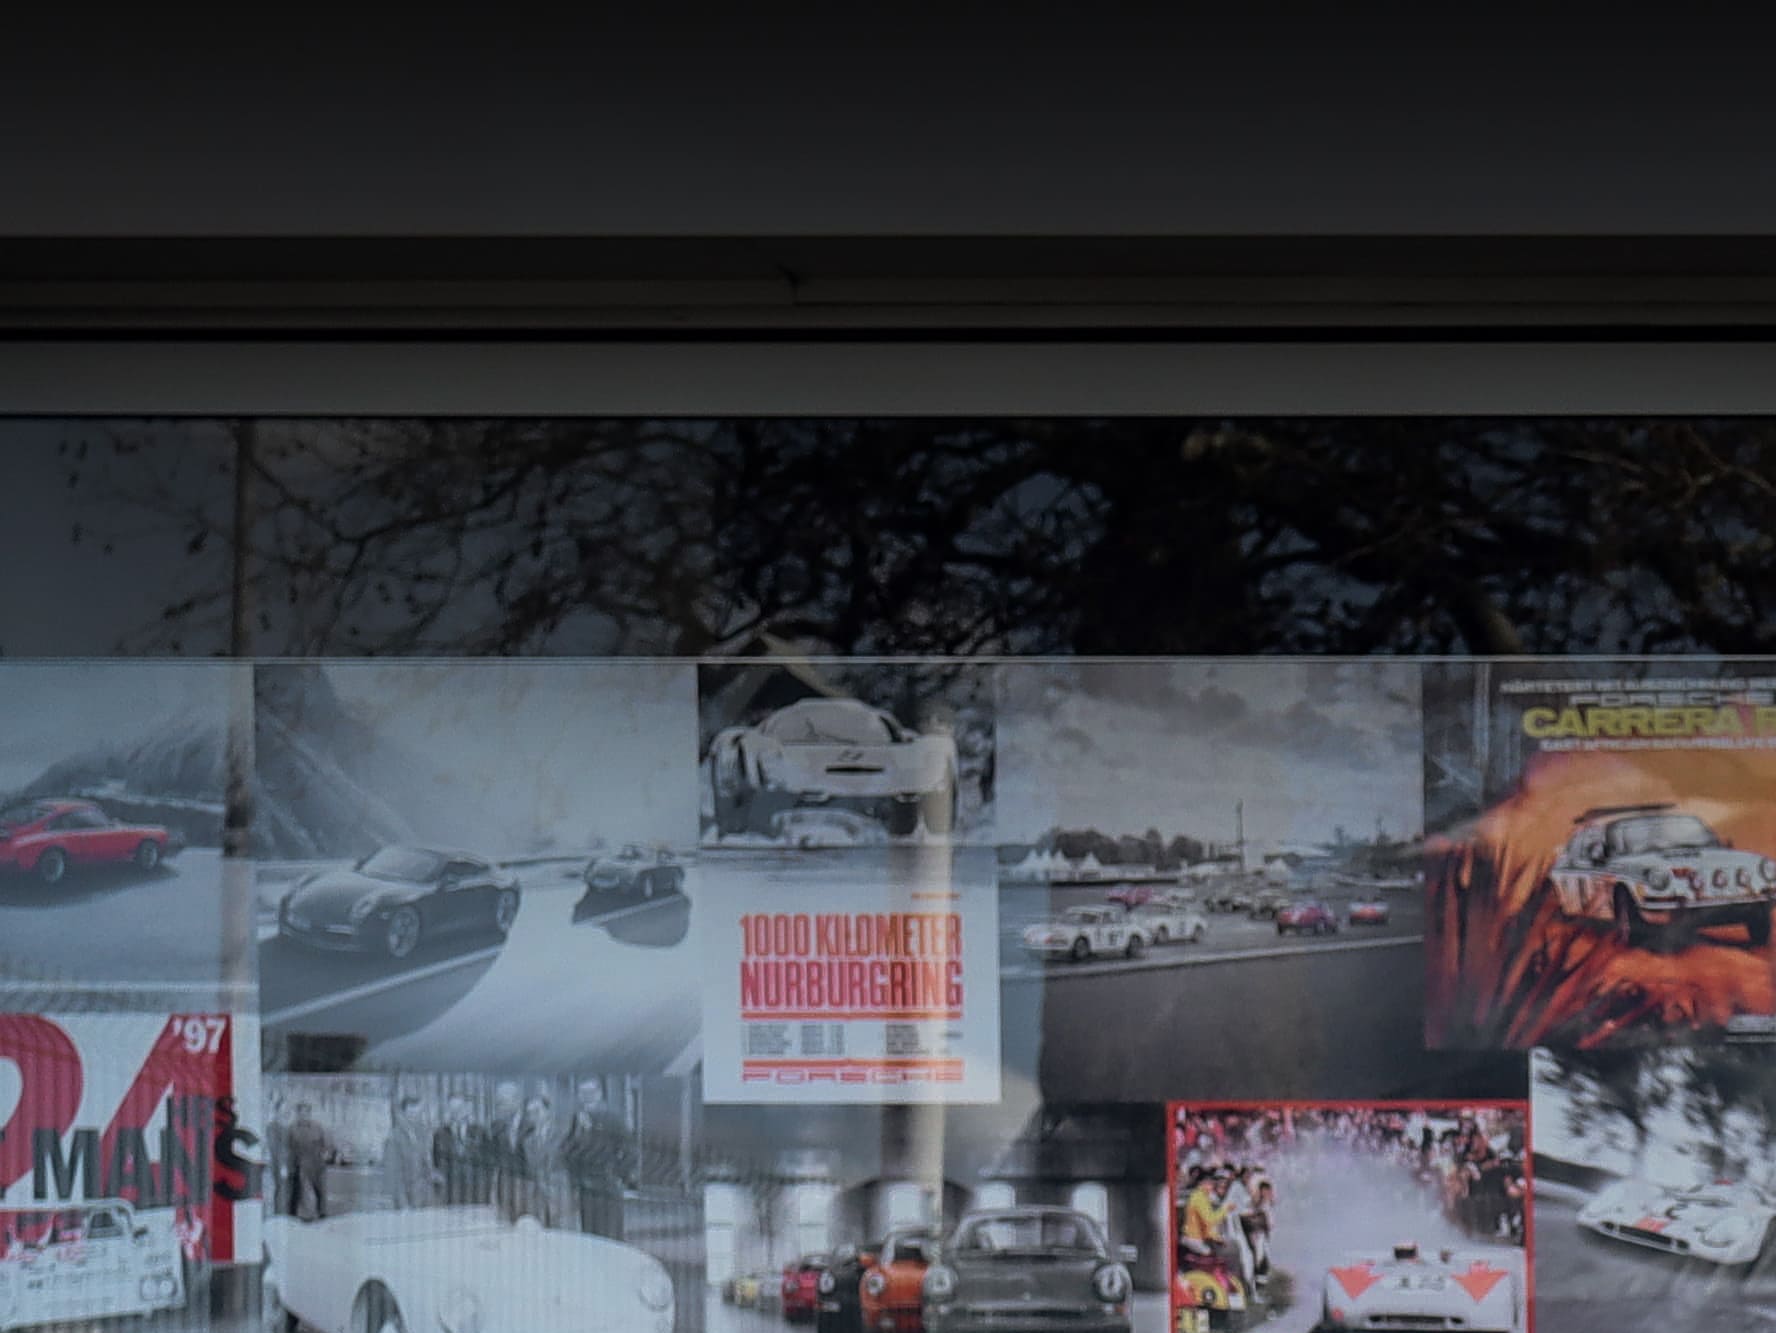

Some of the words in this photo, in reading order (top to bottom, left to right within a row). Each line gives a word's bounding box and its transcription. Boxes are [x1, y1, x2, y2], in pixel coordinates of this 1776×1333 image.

[1521, 706, 1741, 738] CARRERA
[740, 913, 810, 956] 1000
[816, 912, 962, 956] KILOMETER
[172, 1018, 227, 1053] '97
[32, 1127, 264, 1209] MANS
